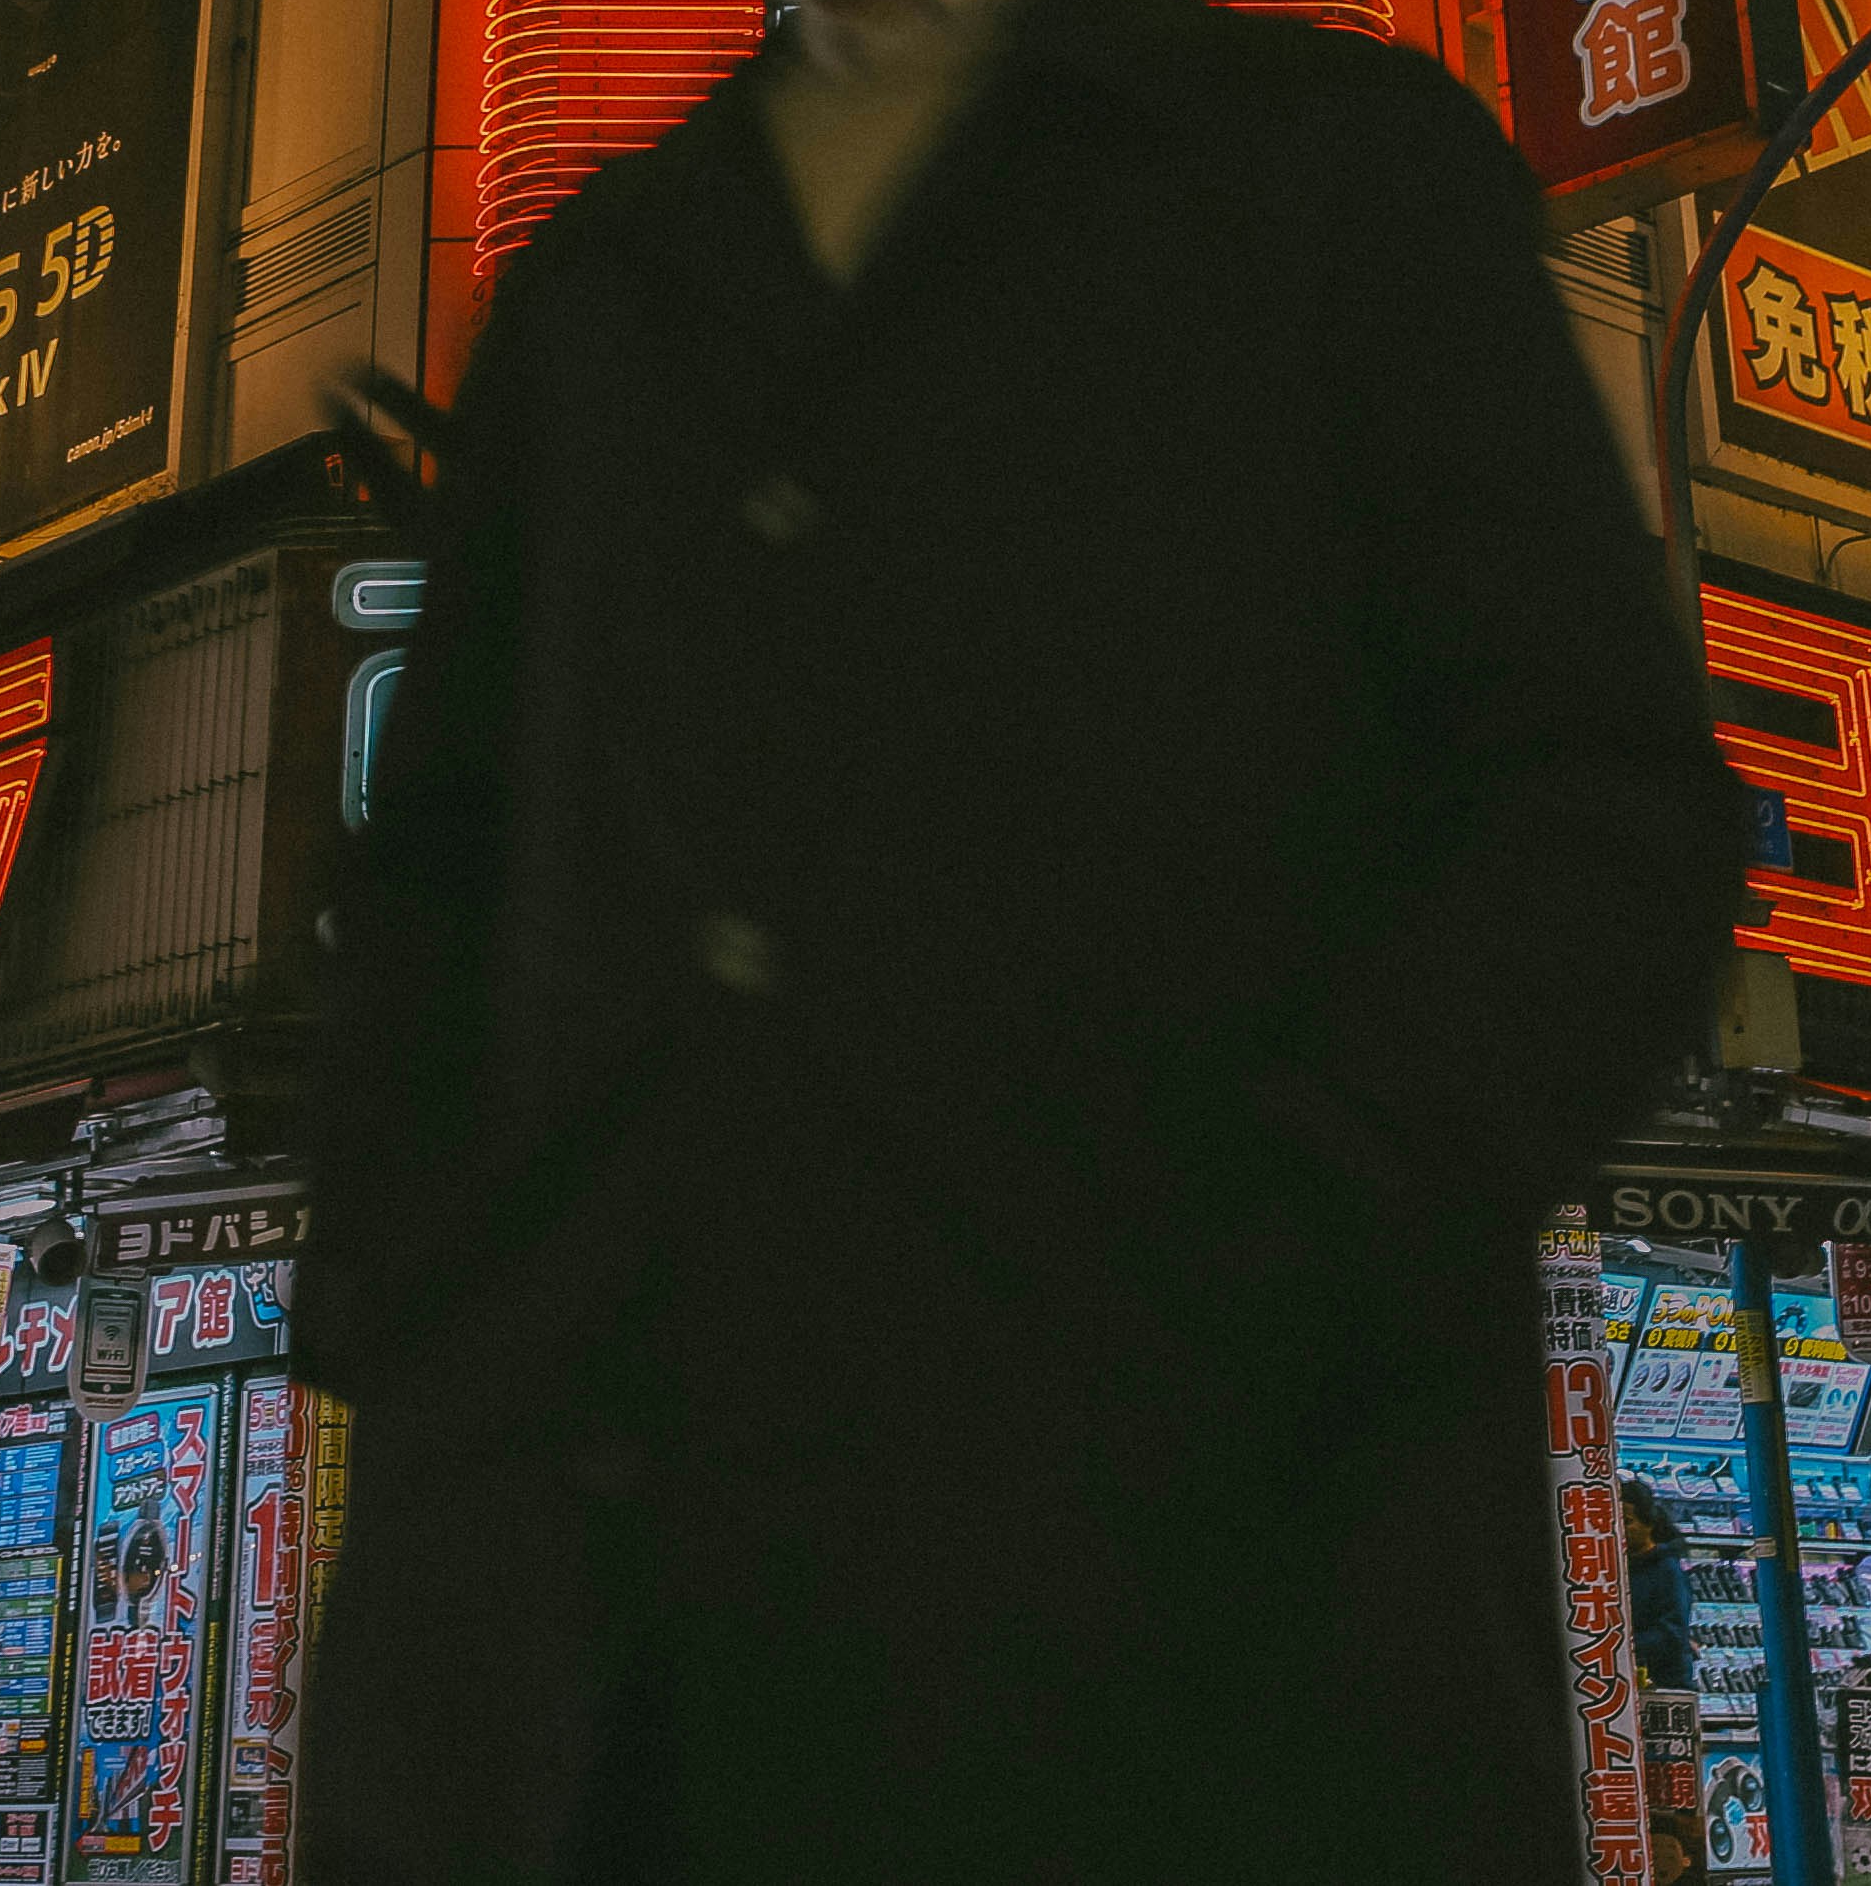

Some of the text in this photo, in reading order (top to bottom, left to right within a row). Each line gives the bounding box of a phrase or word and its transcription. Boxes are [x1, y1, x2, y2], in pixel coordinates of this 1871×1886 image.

[34, 202, 117, 322] 5D
[17, 338, 61, 411] IV
[1610, 1185, 1806, 1233] SONY
[84, 1624, 161, 1708] 試着
[147, 1404, 209, 1855] スマートウォッチ
